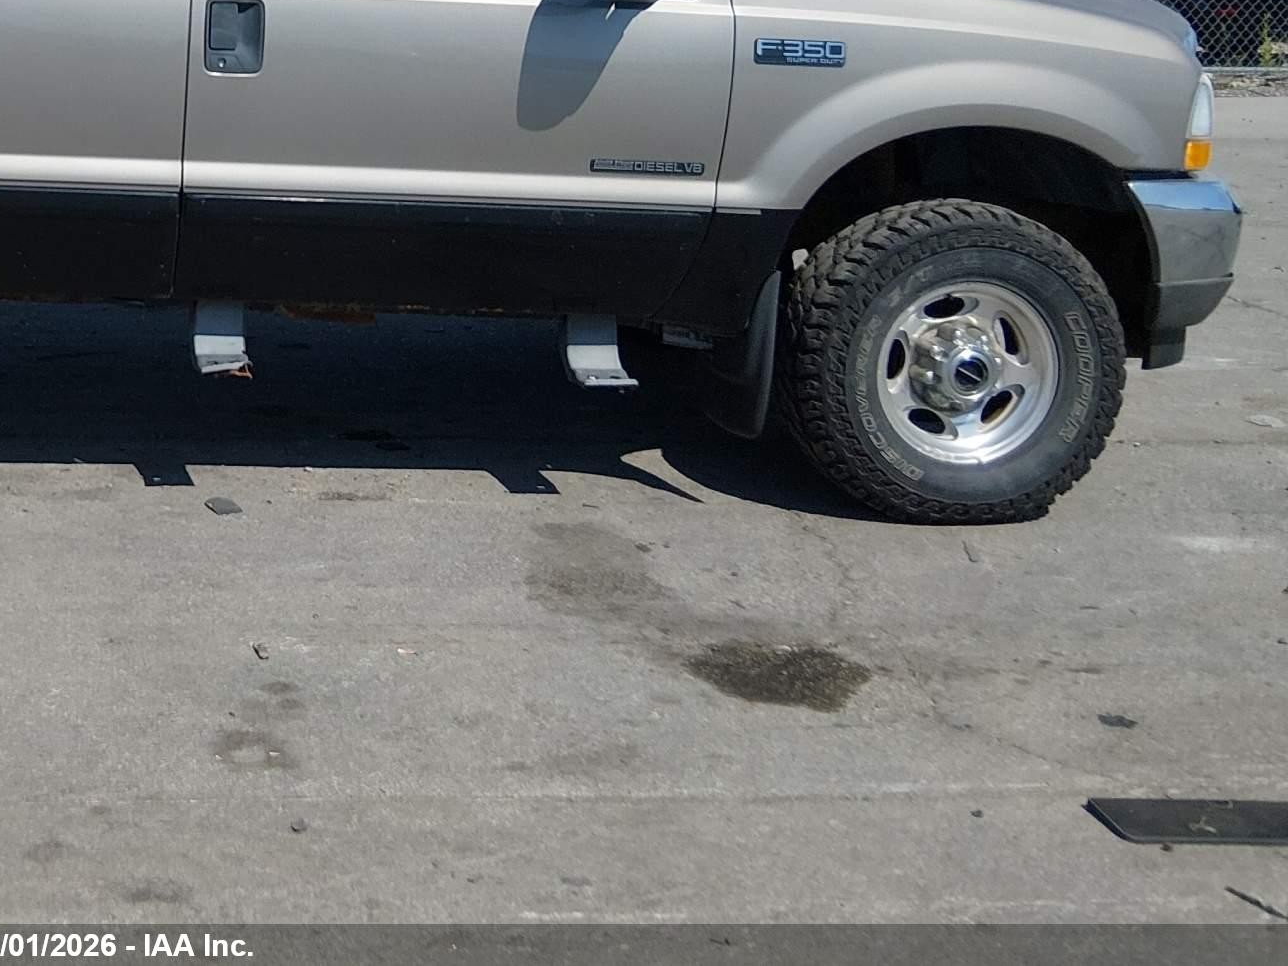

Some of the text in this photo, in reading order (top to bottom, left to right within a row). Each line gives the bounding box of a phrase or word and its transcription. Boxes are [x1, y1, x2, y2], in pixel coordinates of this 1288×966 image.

[786, 56, 844, 65] SUPER DUTY
[634, 161, 683, 173] DIESEL
[684, 162, 703, 174] V8
